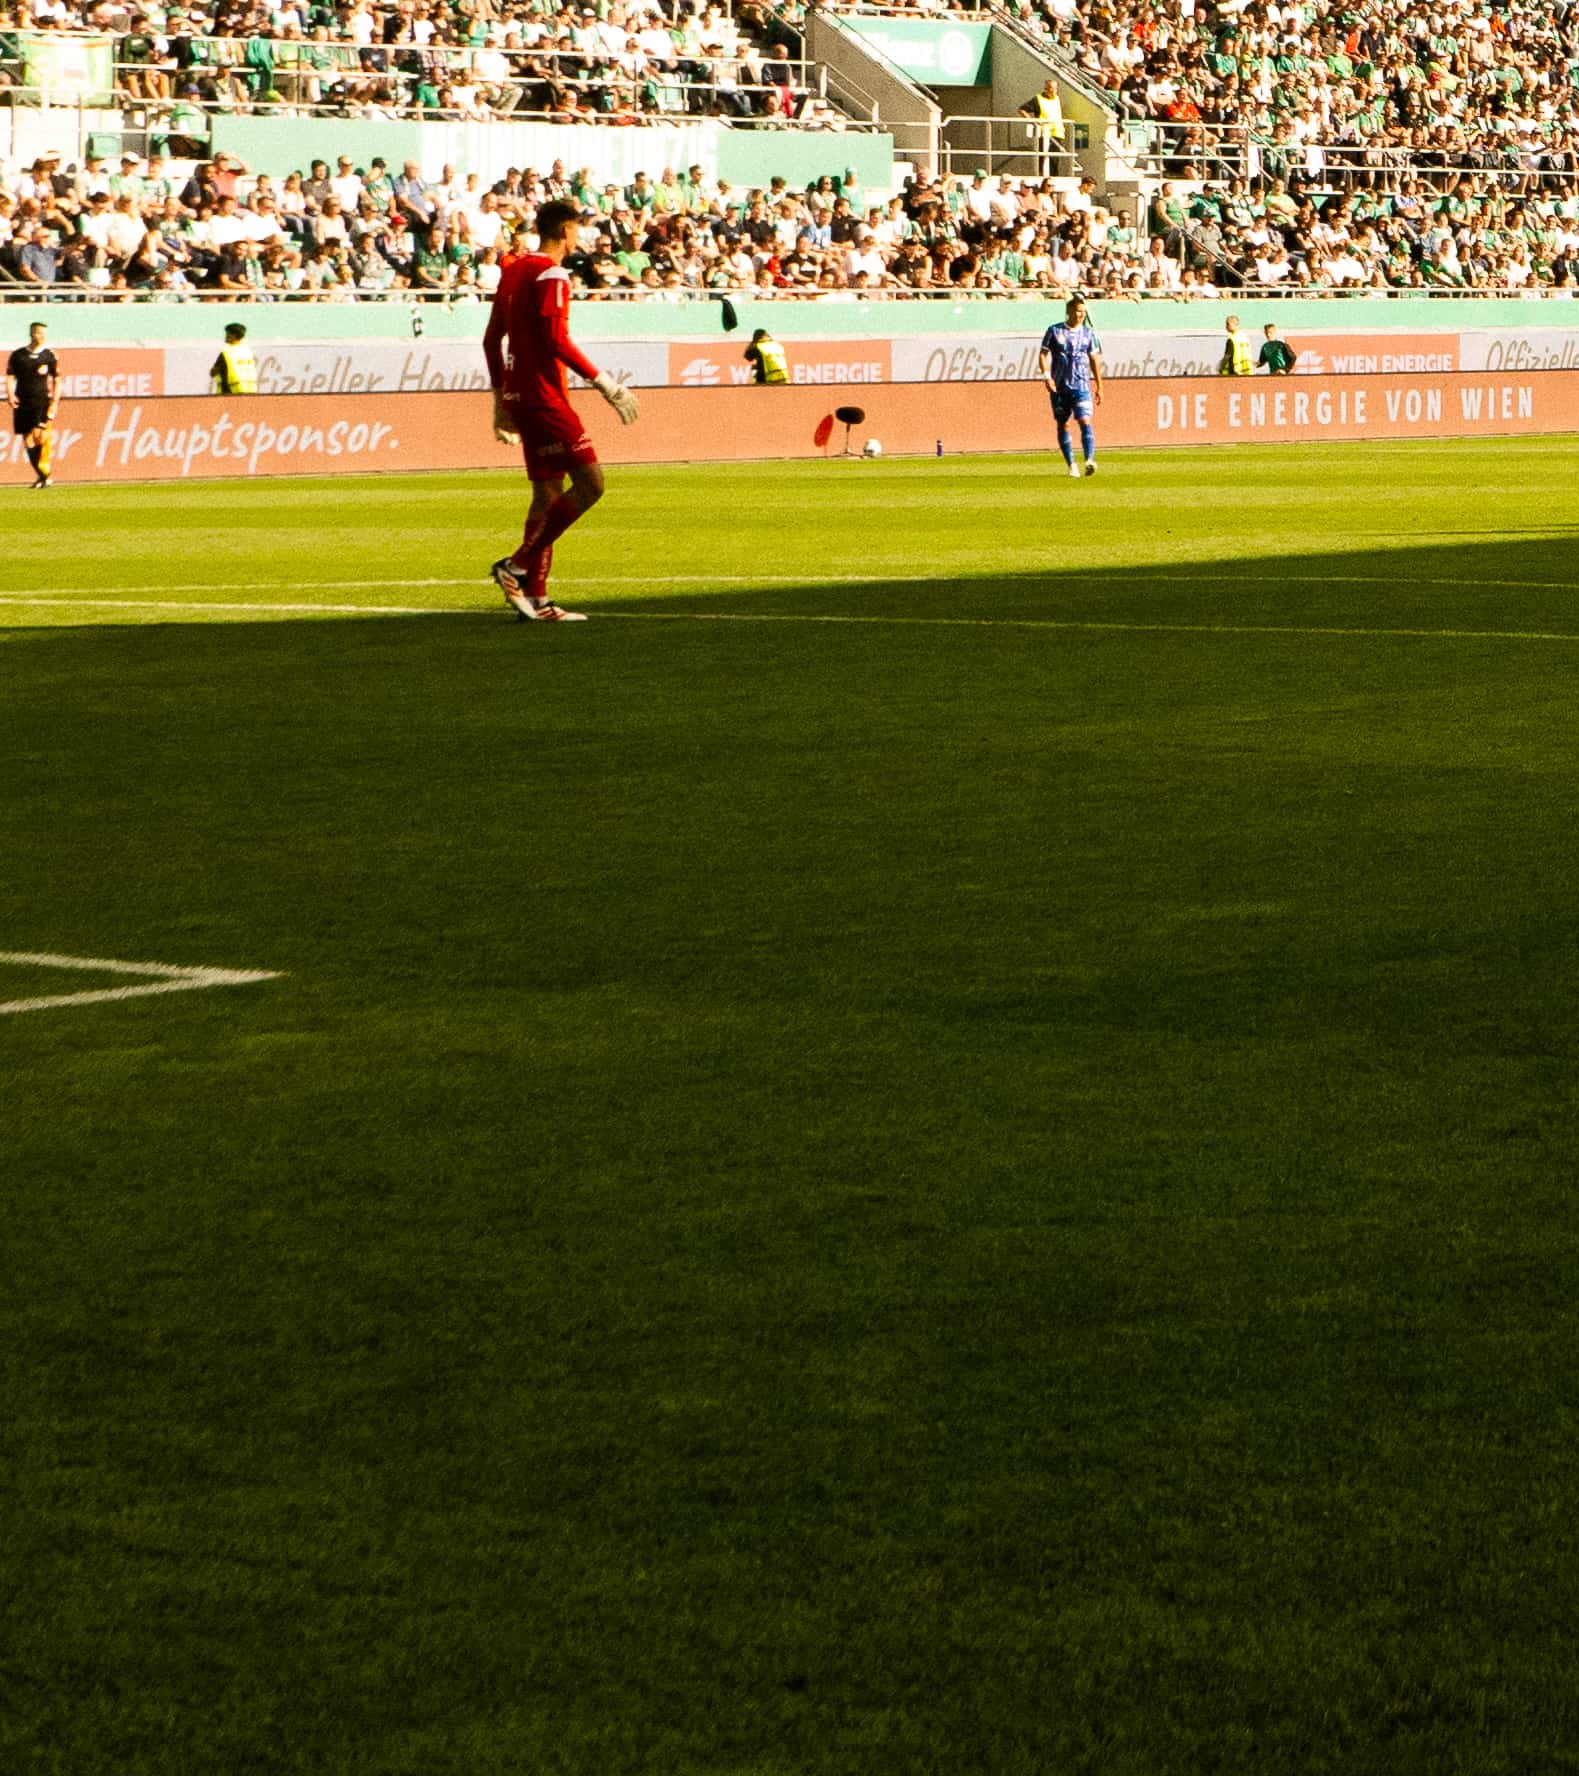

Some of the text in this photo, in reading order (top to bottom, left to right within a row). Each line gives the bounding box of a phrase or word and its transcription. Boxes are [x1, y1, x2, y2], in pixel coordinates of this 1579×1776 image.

[795, 362, 883, 384] ENERGIE
[1331, 353, 1454, 374] WIEN ENERGIE
[1157, 385, 1534, 430] DIE ENERGIE VON WIEN
[96, 403, 399, 476] Hauptsponsor.
